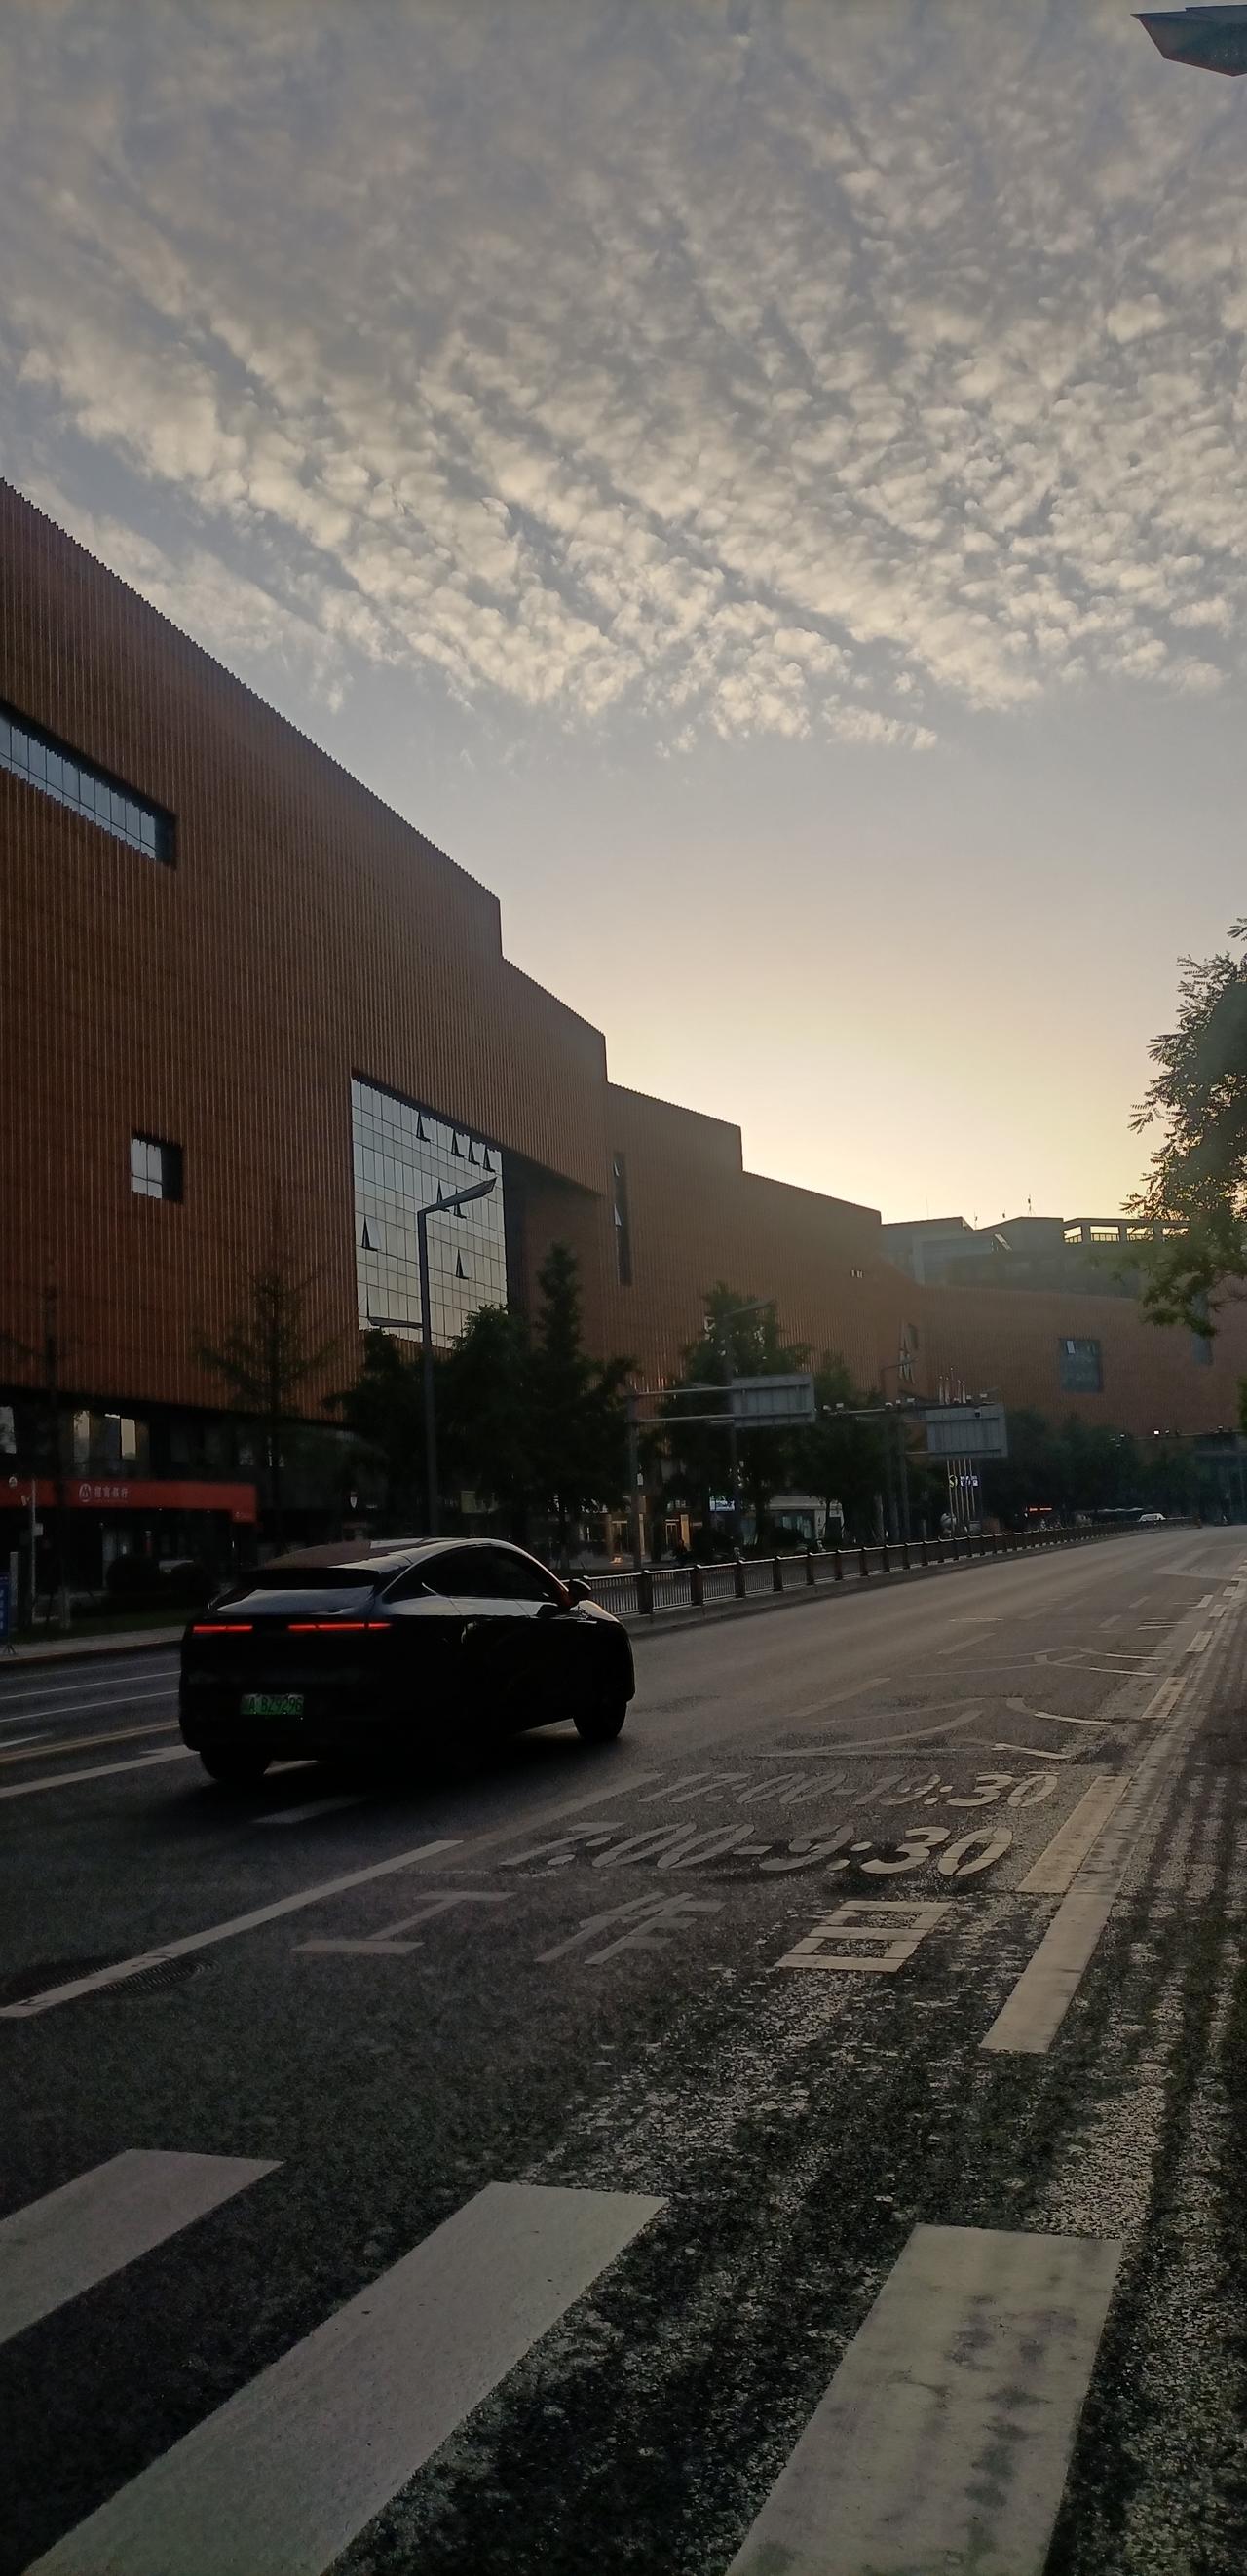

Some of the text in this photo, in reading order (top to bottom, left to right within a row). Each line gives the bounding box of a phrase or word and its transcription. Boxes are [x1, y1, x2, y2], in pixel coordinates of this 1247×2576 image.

[241, 1696, 302, 1713] ABZ9296
[638, 1771, 1059, 1807] 17:00-19:30
[499, 1822, 1013, 1876] 7:00-9:30
[292, 1891, 953, 1973] 工作日
